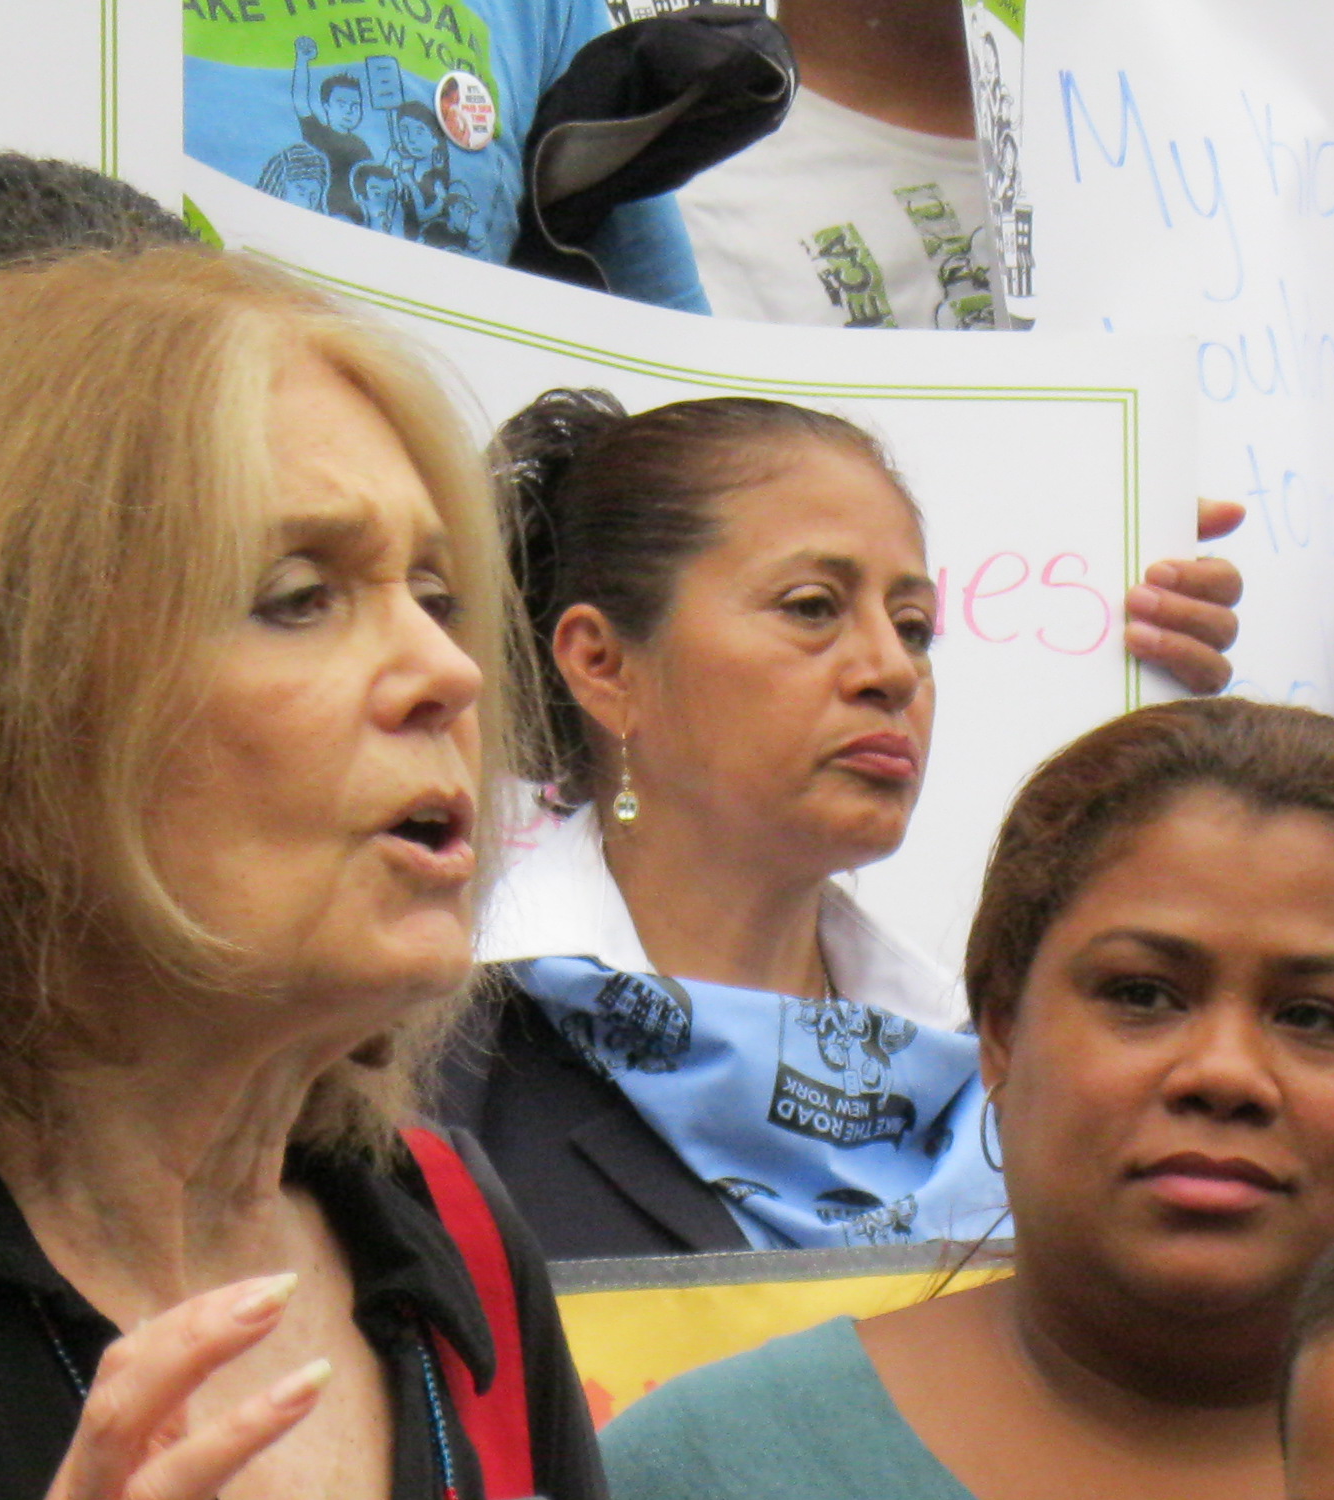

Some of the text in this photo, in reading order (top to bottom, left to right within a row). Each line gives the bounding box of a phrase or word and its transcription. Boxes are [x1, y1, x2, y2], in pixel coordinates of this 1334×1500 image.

[328, 16, 406, 49] NEW
[1058, 68, 1244, 302] My
[782, 1075, 870, 1118] NEW YORK
[776, 1098, 844, 1139] ROAD
